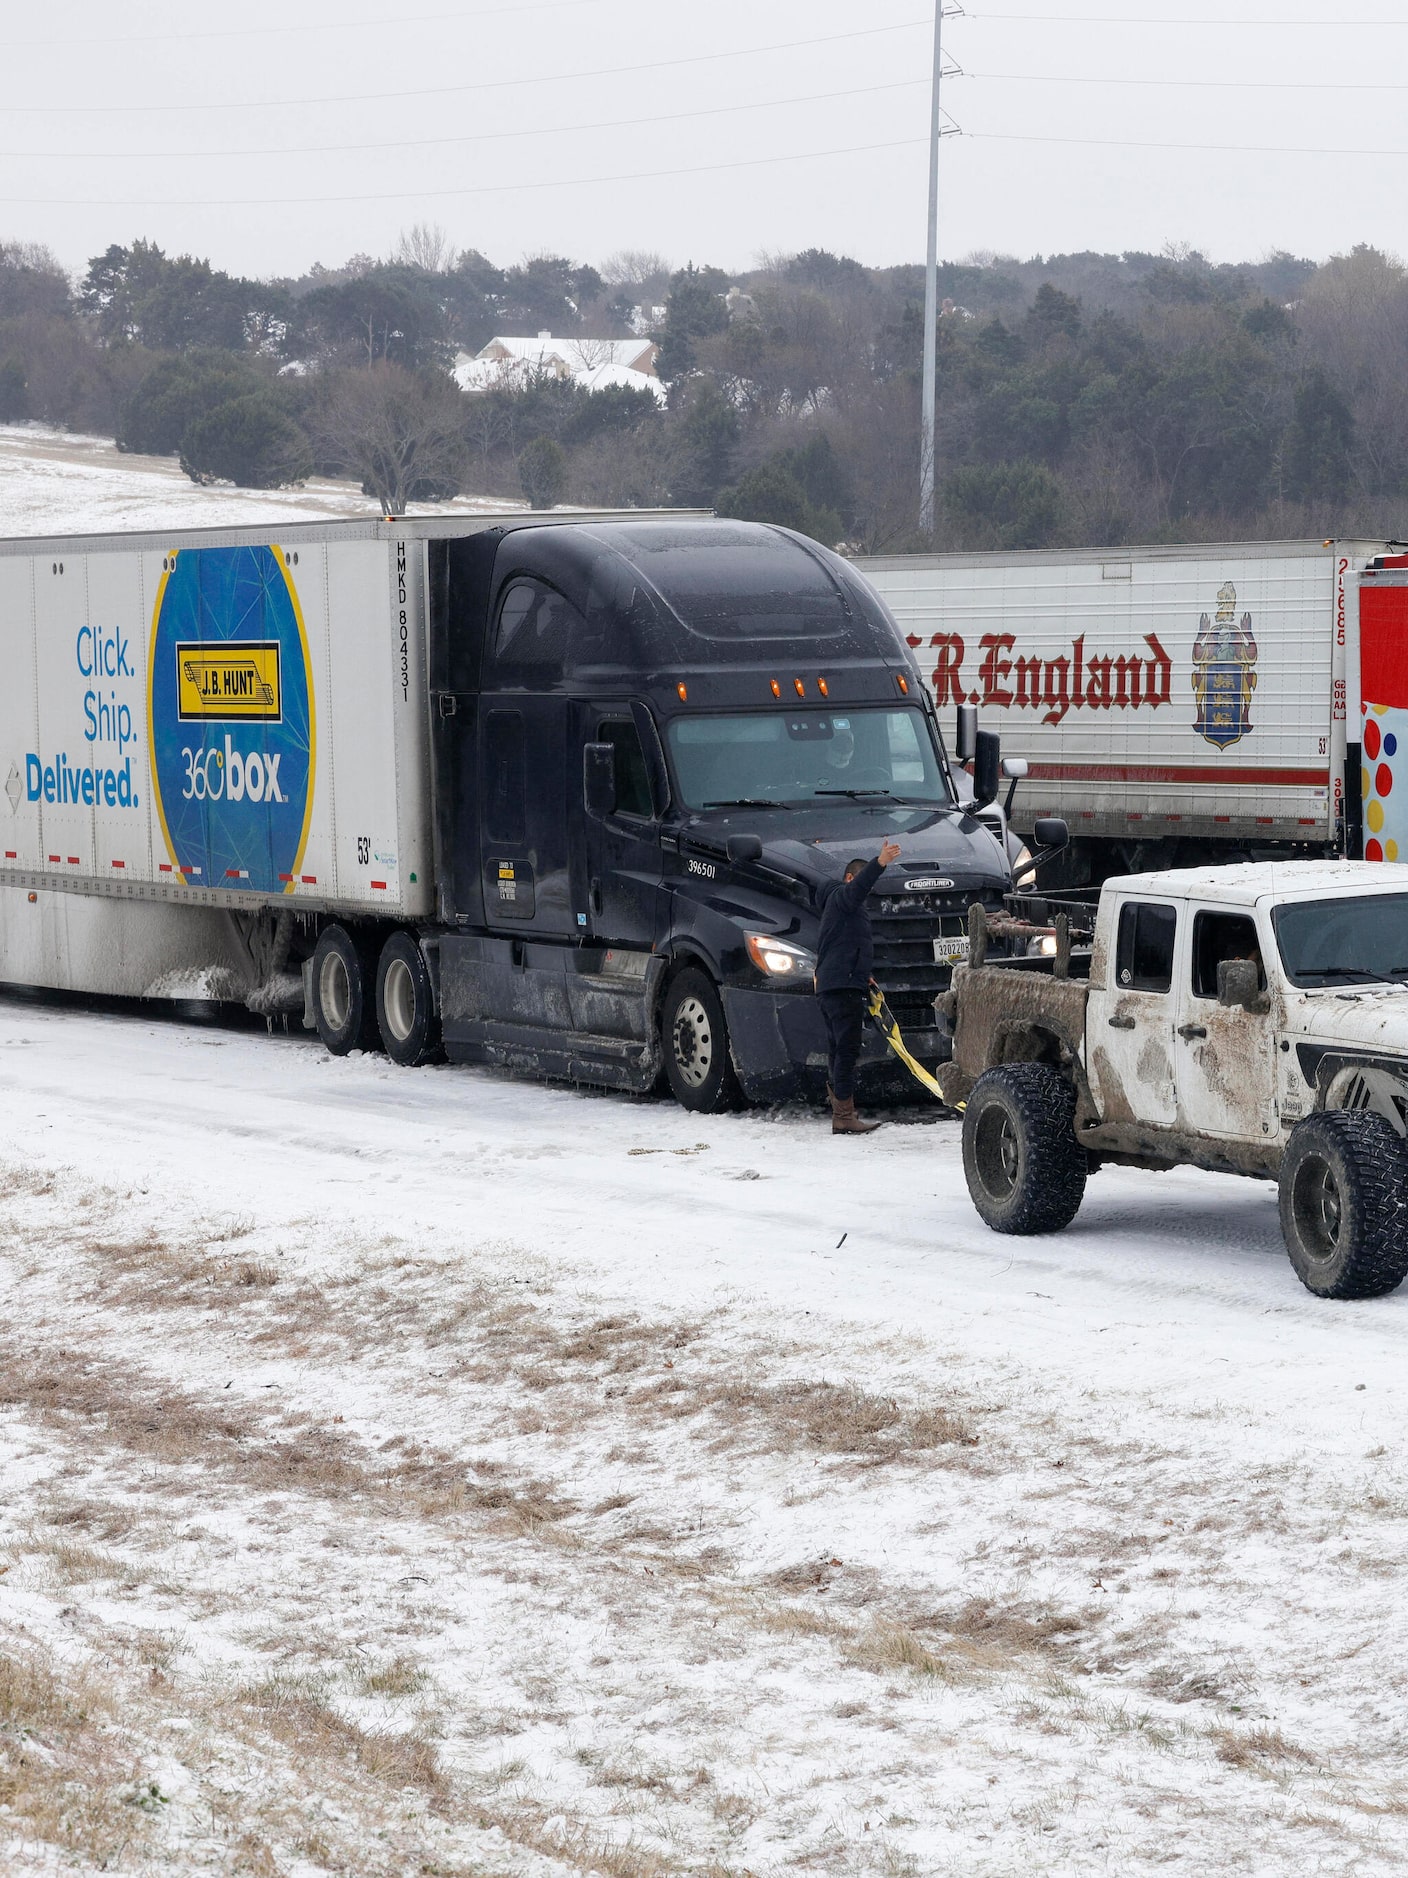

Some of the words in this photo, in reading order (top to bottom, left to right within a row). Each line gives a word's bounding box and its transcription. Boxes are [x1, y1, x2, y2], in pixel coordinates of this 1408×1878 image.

[397, 541, 406, 604] HMKD
[77, 625, 135, 677] Click.
[399, 610, 409, 703] 804331
[224, 670, 254, 695] HUNT
[84, 690, 137, 755] Ship.
[26, 752, 139, 808] Delivered.
[688, 859, 716, 879] 396501
[909, 879, 951, 889] FREIGHTLINER
[1281, 1097, 1303, 1114] Jeep
